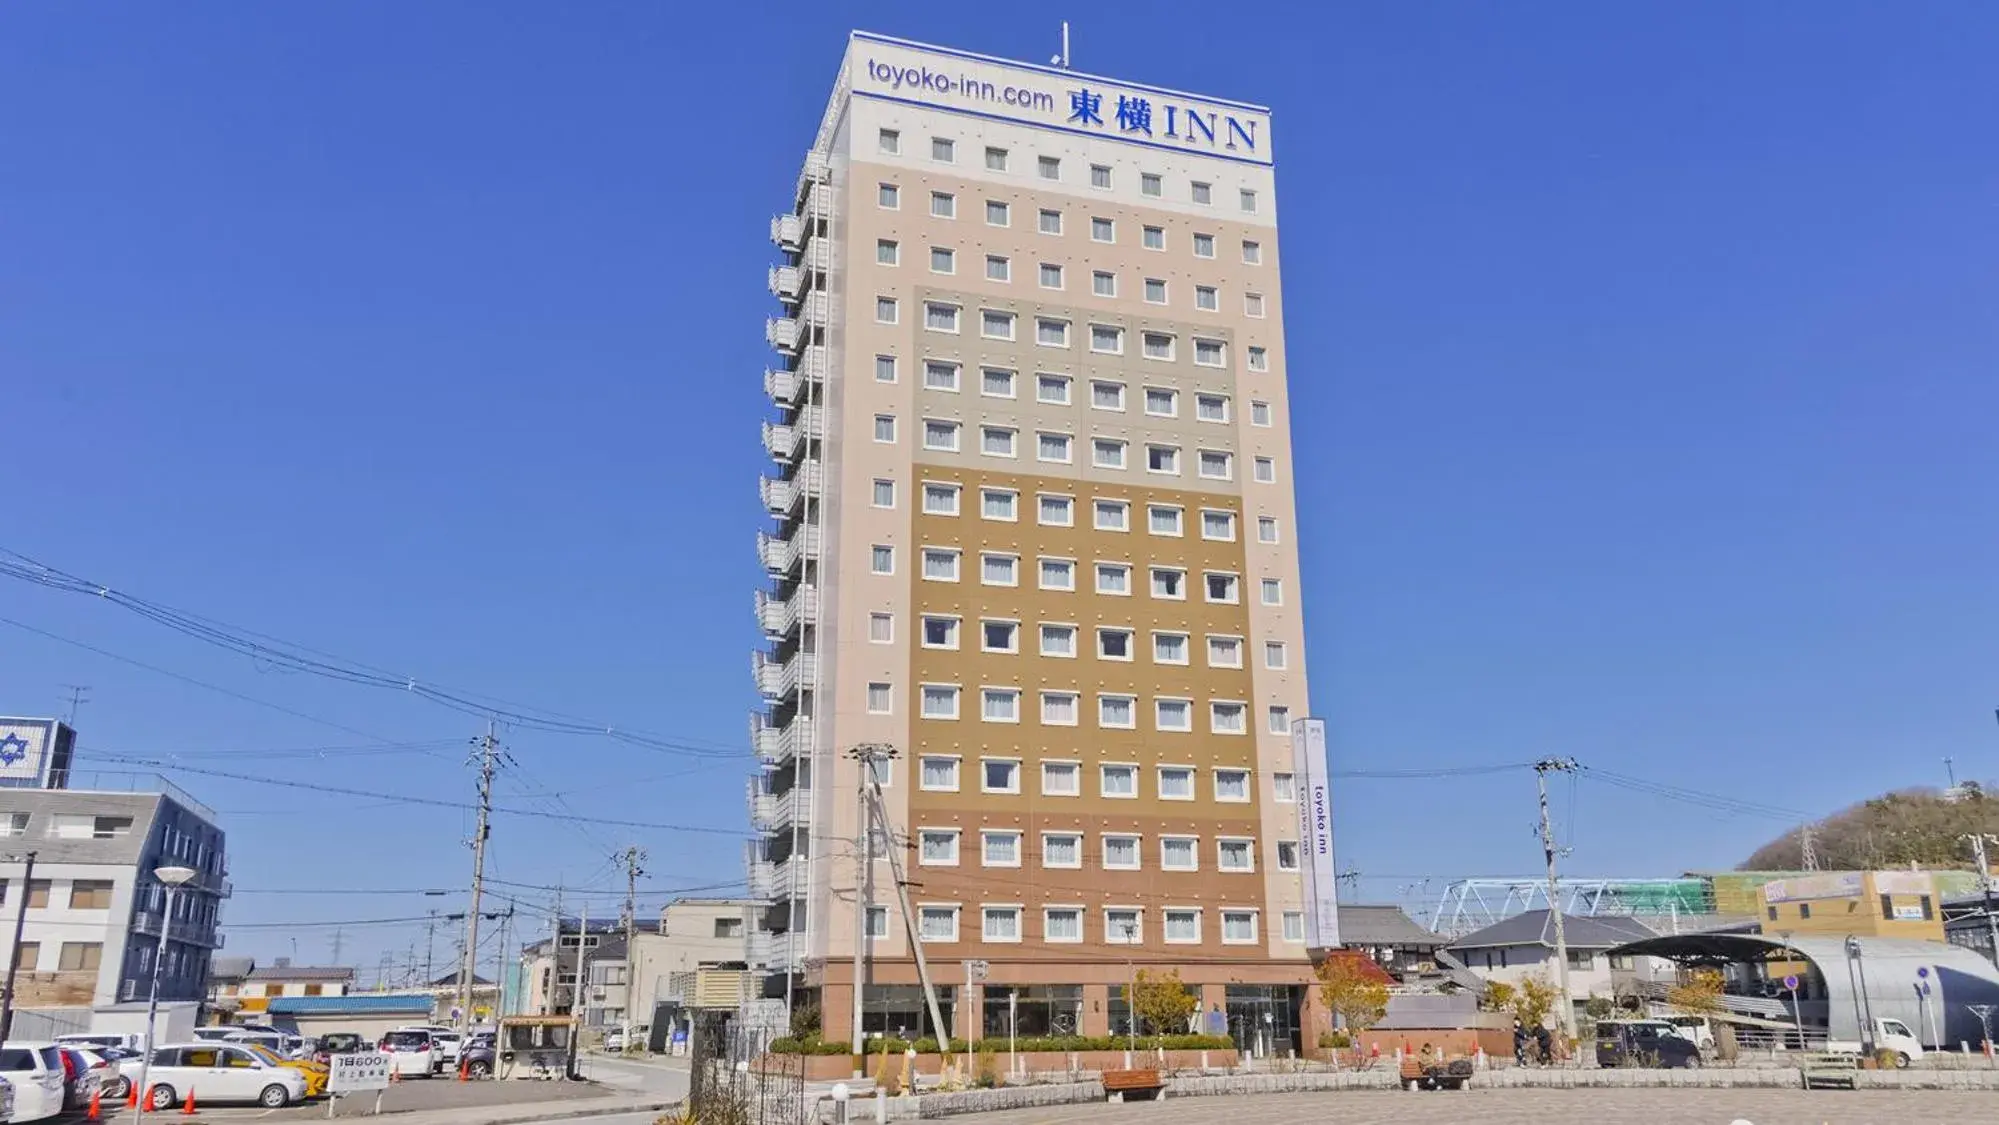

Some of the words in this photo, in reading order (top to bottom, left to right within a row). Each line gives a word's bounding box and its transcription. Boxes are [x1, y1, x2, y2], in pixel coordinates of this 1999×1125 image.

[868, 58, 1054, 112] toyoko-inn.com
[1314, 785, 1326, 830] toyoko
[1319, 833, 1327, 854] inn
